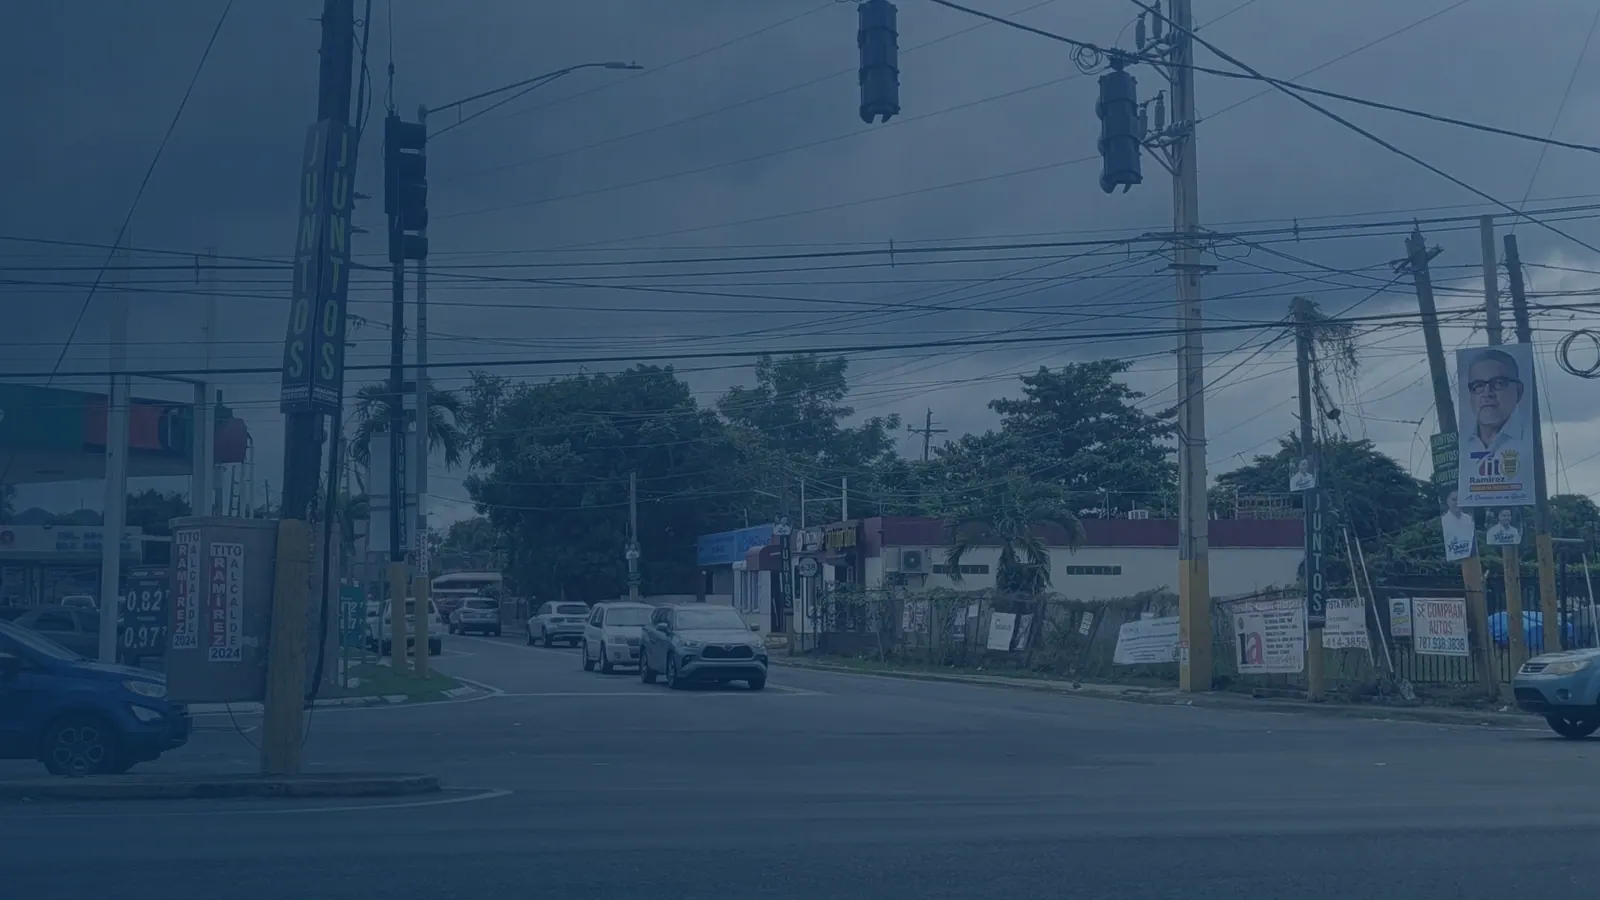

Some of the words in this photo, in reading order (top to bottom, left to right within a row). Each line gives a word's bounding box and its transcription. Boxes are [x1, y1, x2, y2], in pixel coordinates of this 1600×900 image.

[290, 129, 319, 379] JUNTOS
[321, 131, 349, 381] JUNTOS
[177, 531, 200, 543] TITO
[212, 545, 242, 556] TITO
[1312, 493, 1322, 612] JUNTOS
[230, 559, 240, 645] ALCALDE
[1427, 603, 1463, 618] COMPRAN
[1429, 620, 1453, 635] AUTOS
[174, 635, 196, 646] 2024
[211, 648, 240, 659] 2024
